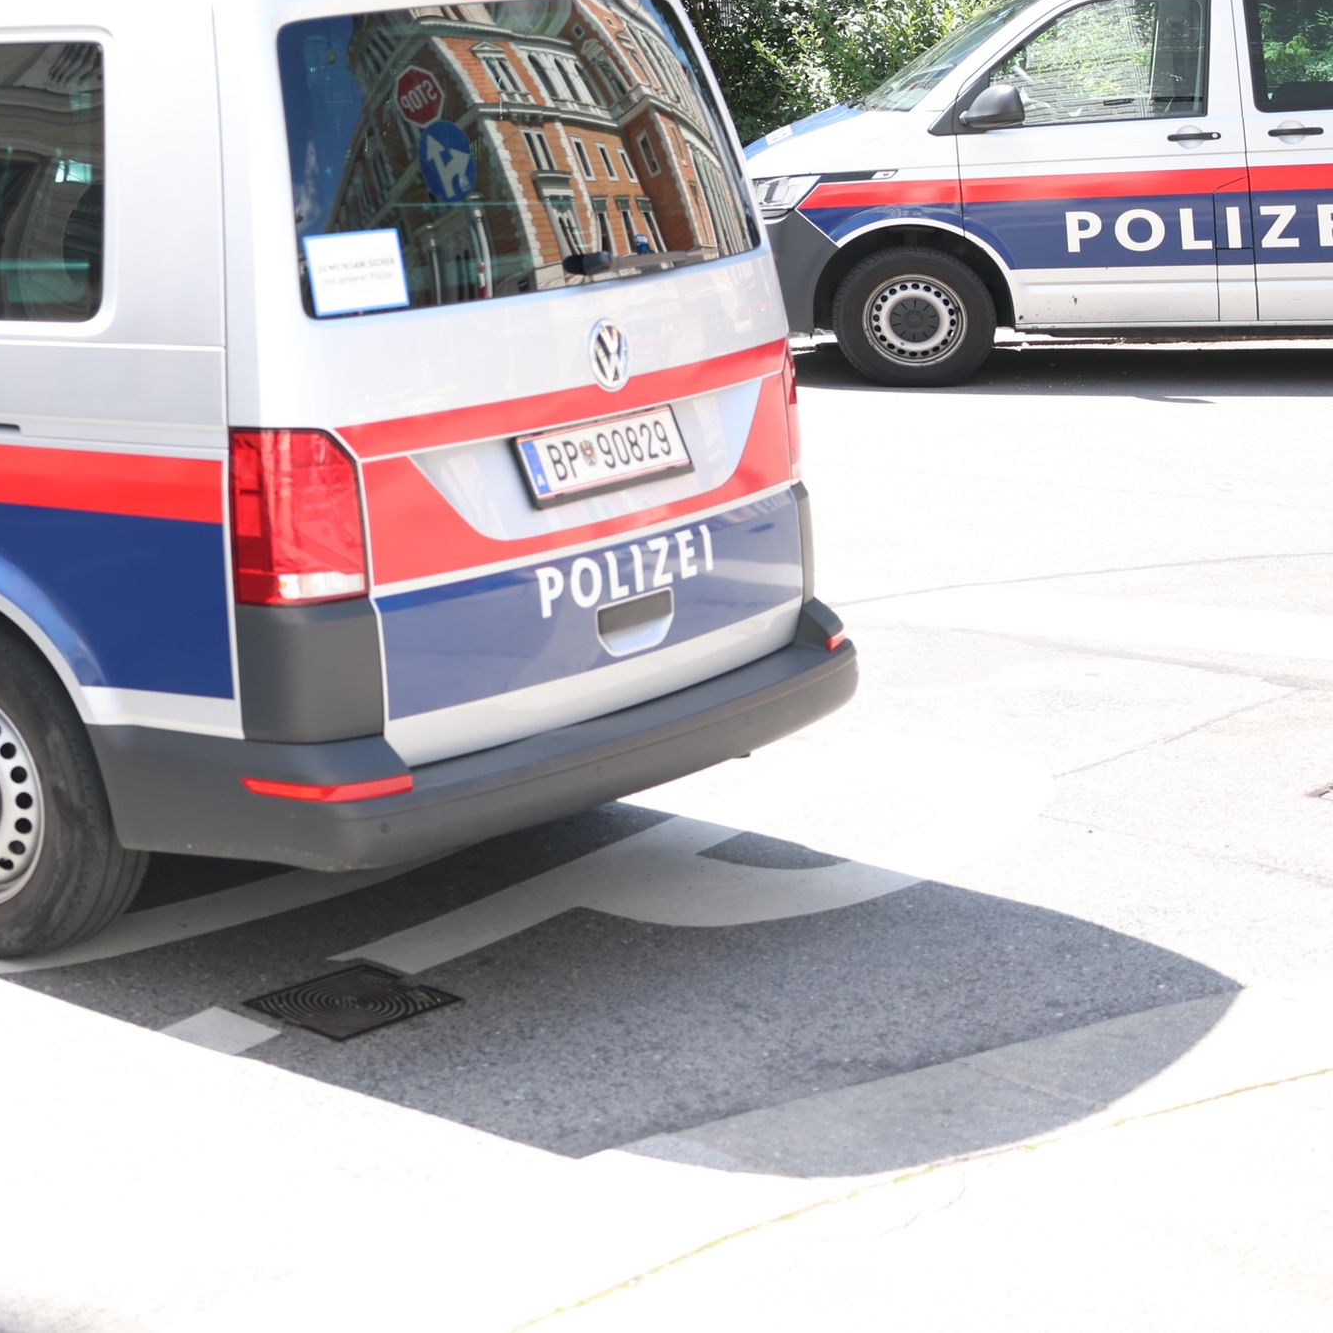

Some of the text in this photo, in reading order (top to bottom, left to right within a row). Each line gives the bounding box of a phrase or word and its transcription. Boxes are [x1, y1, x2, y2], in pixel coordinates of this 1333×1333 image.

[1065, 202, 1333, 253] POLIZE
[546, 420, 672, 482] BP 90829
[535, 524, 714, 619] POLIZEI
